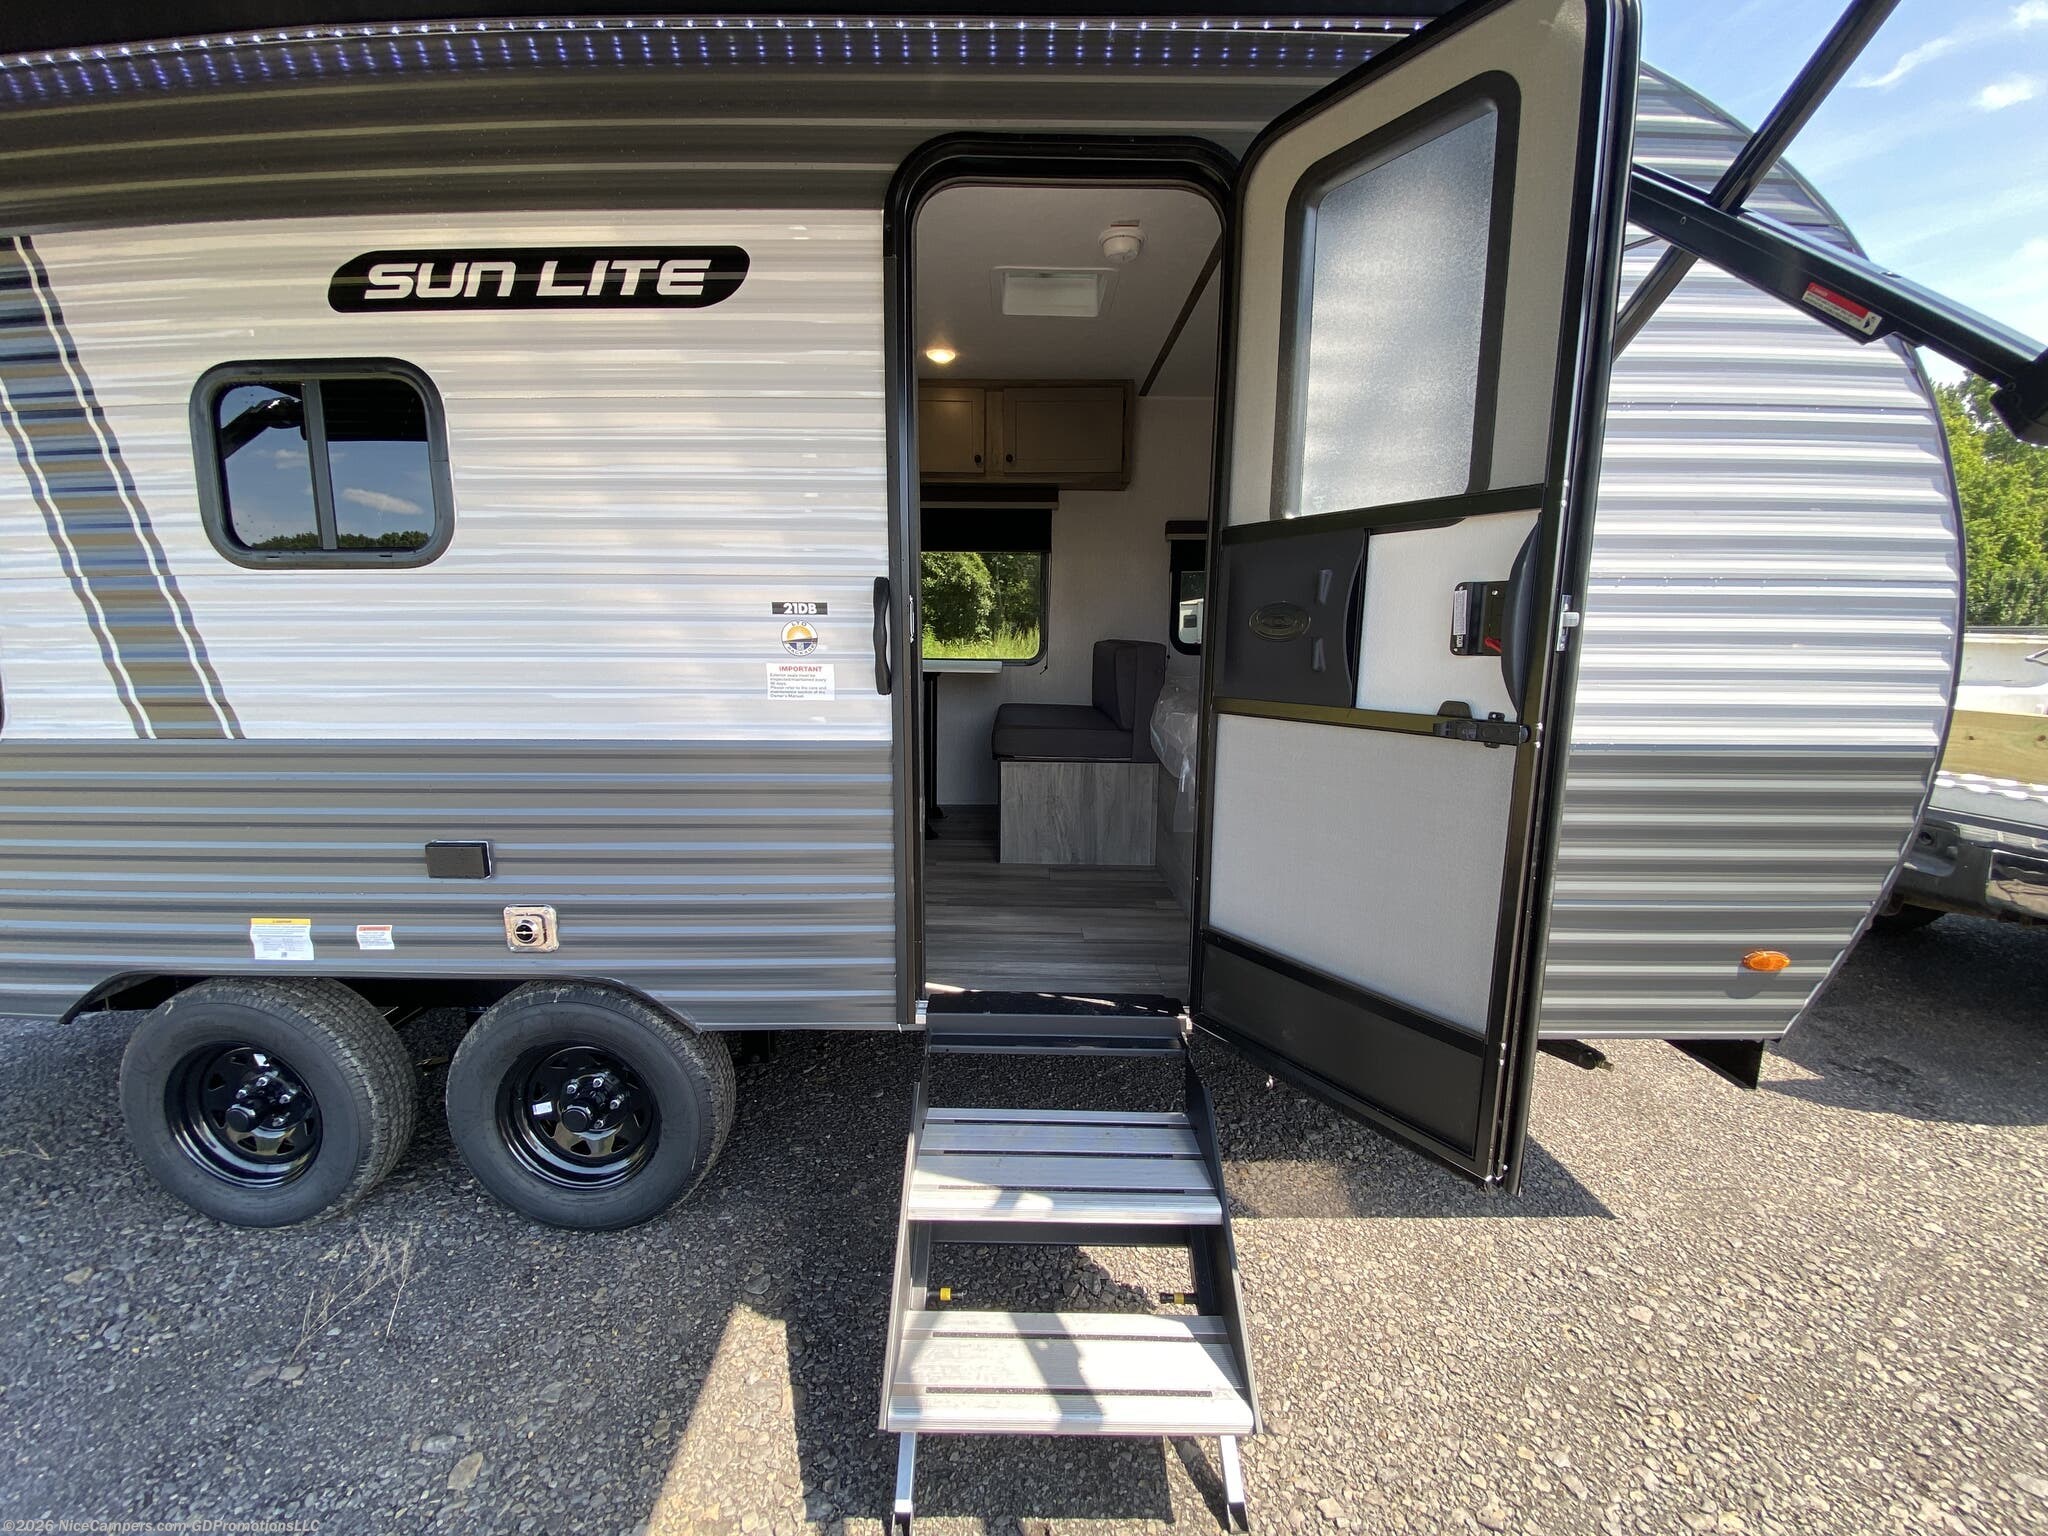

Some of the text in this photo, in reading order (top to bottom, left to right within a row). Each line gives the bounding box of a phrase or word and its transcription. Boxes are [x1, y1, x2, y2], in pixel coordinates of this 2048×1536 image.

[364, 259, 712, 300] SUN LITE
[783, 602, 818, 614] 21DB
